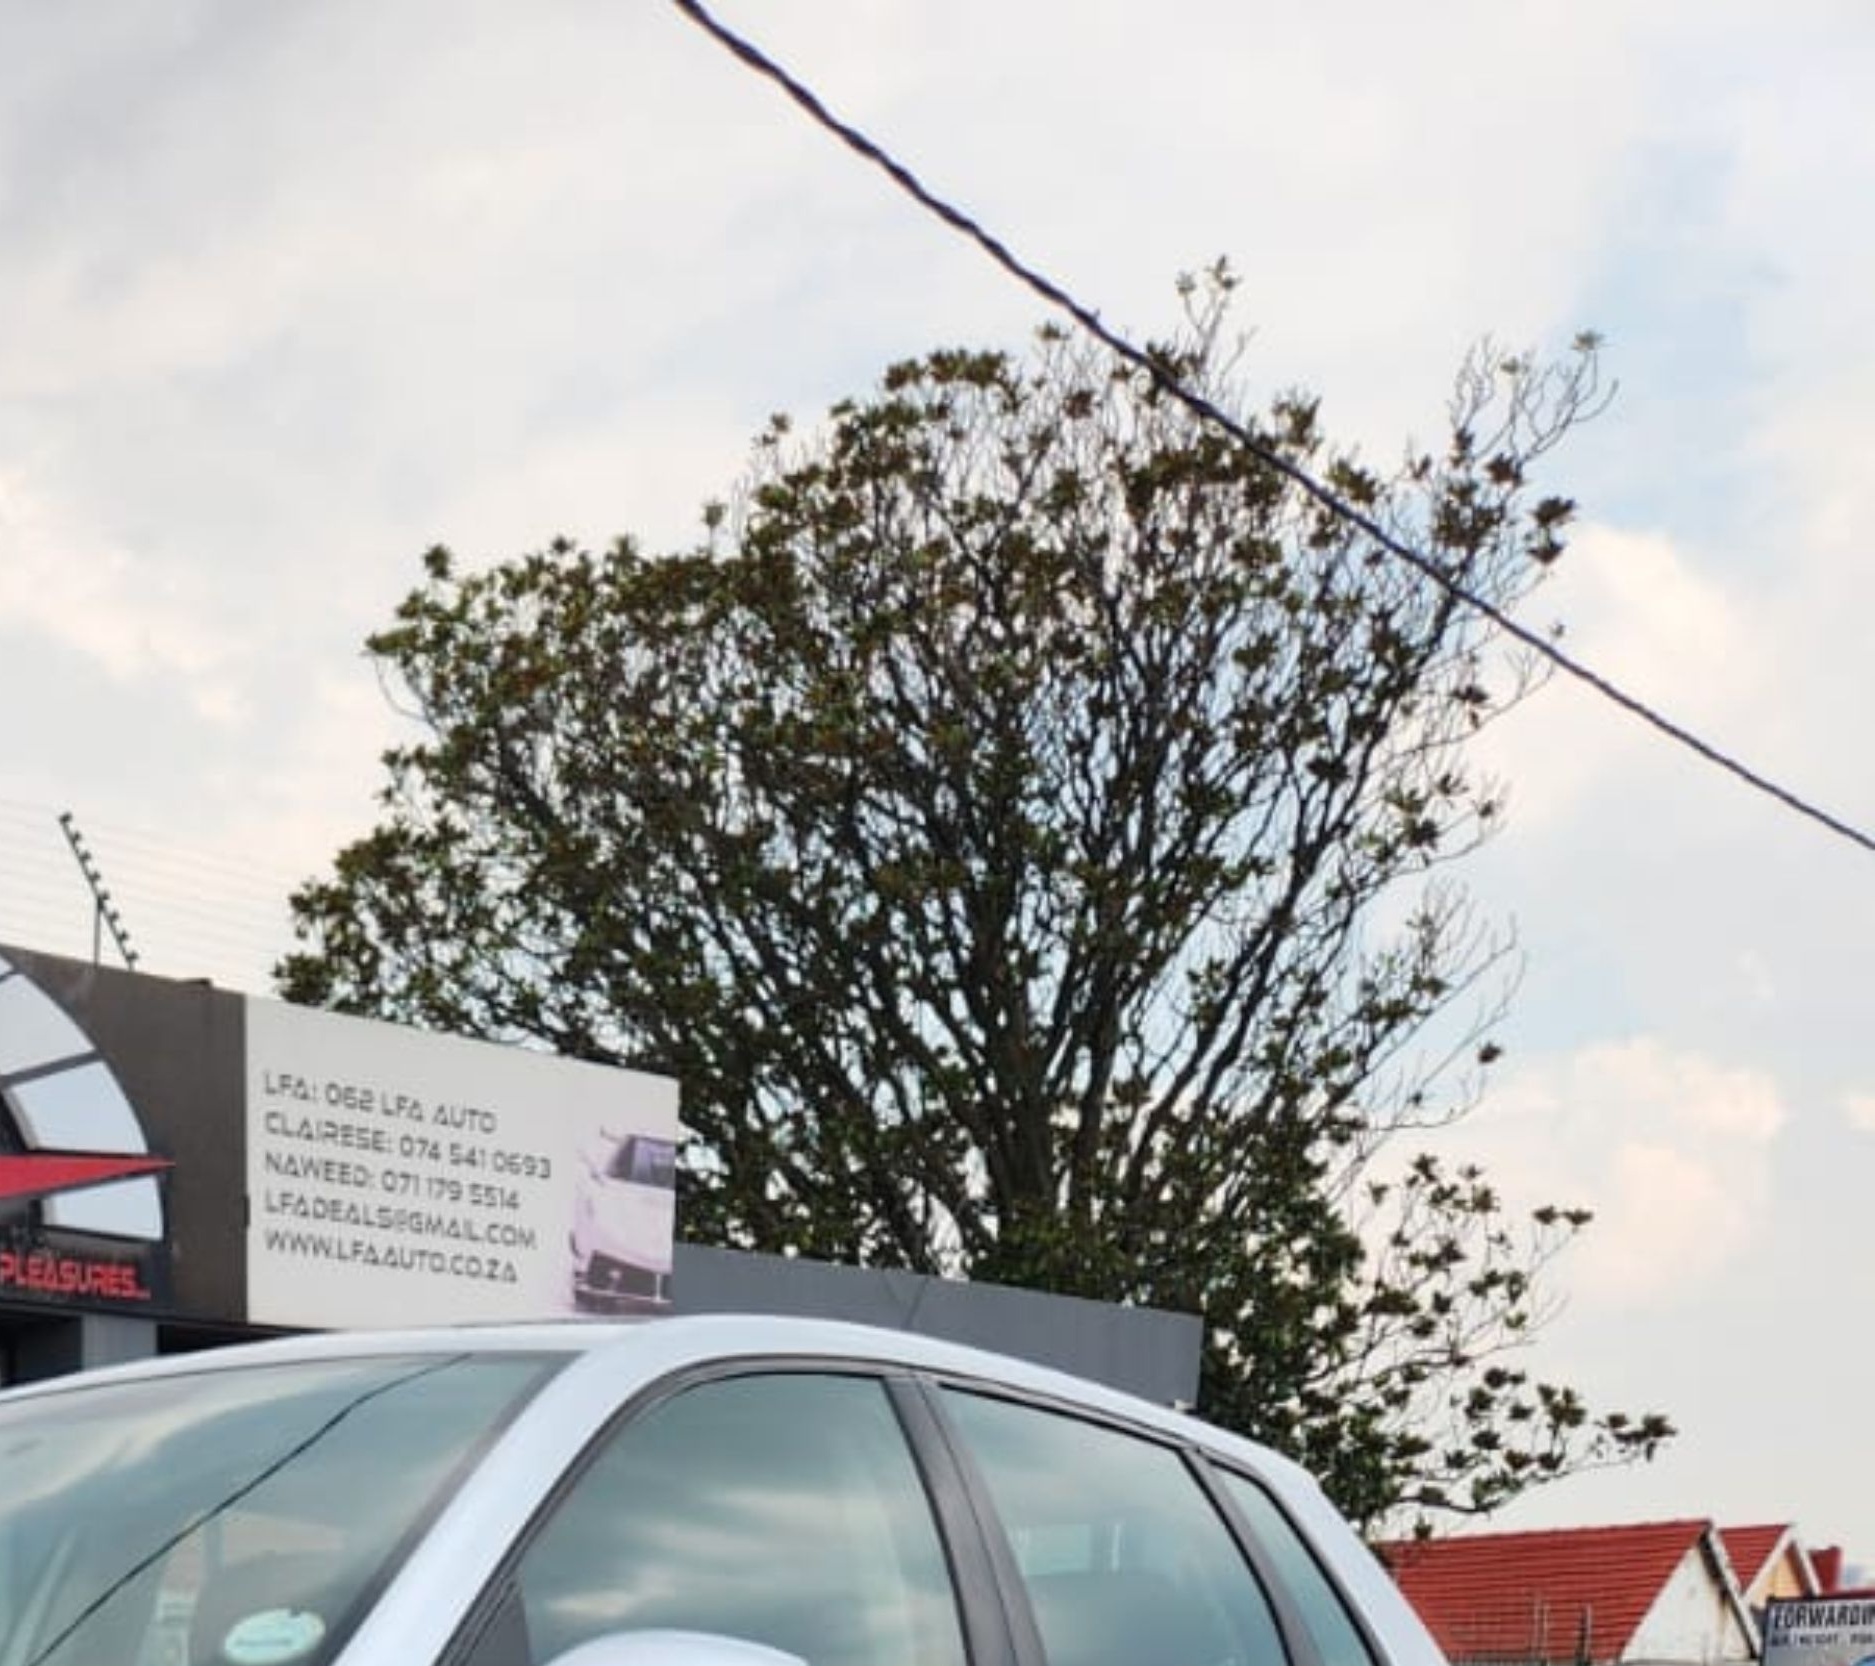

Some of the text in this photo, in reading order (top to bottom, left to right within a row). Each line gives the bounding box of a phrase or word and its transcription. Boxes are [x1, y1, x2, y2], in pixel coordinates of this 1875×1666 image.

[264, 1071, 497, 1134] LFA: 062 LFA AUTO
[264, 1150, 521, 1210] NAWEED: 071 179 5514
[400, 1134, 441, 1160] 074
[449, 1142, 486, 1170] 541
[264, 1189, 537, 1250] LFADEALS@GMAIL.COM
[264, 1230, 518, 1283] WWW.LFAAUTO.CO.ZA
